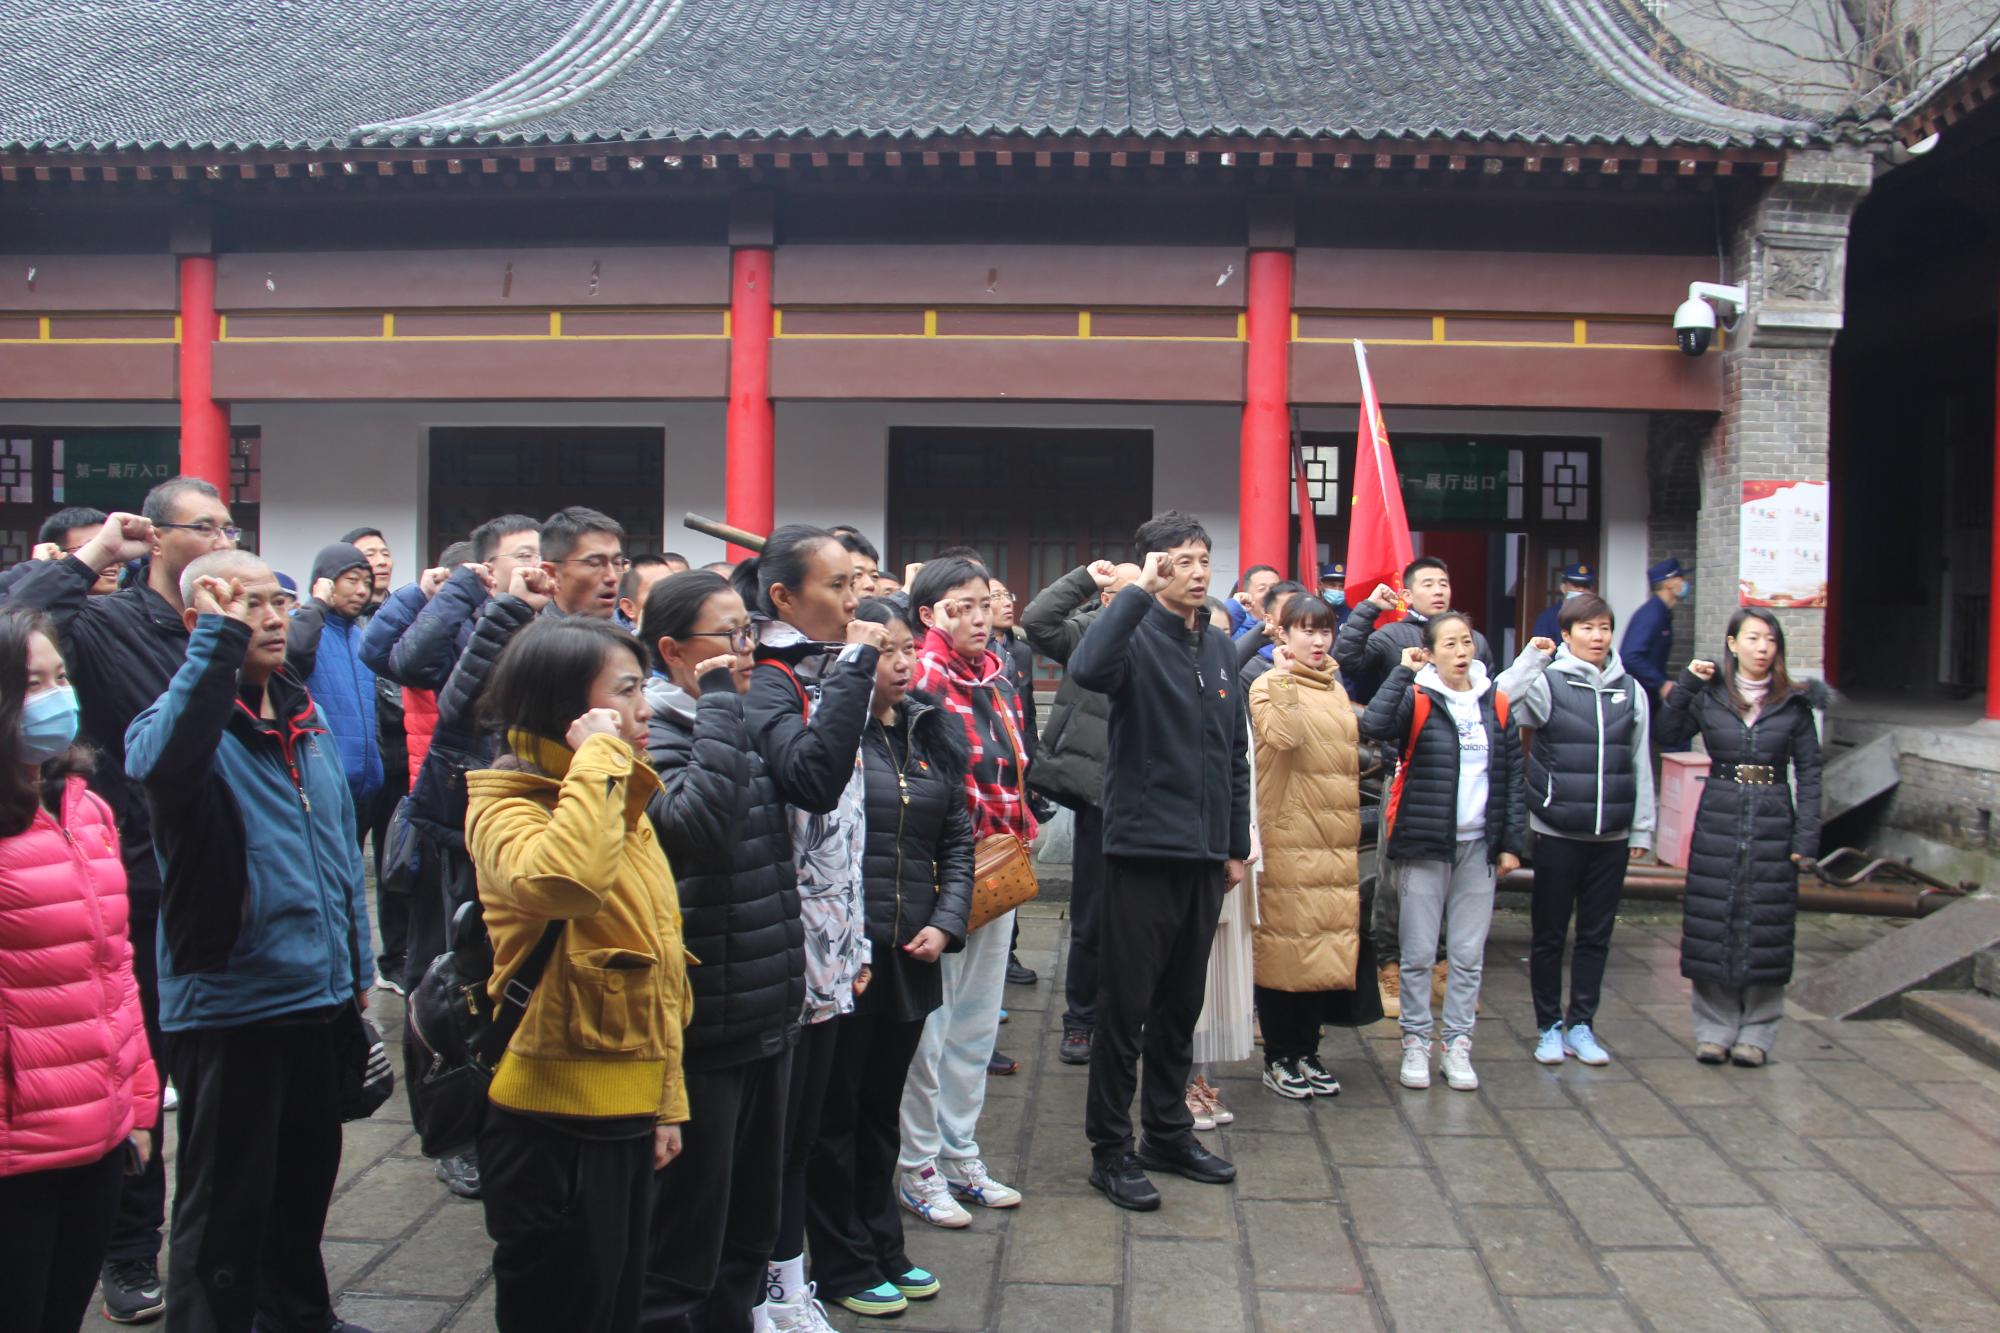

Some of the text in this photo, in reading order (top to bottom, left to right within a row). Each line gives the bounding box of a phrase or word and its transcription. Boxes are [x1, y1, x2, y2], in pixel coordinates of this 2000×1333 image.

[76, 463, 169, 478] 第一展厅入口
